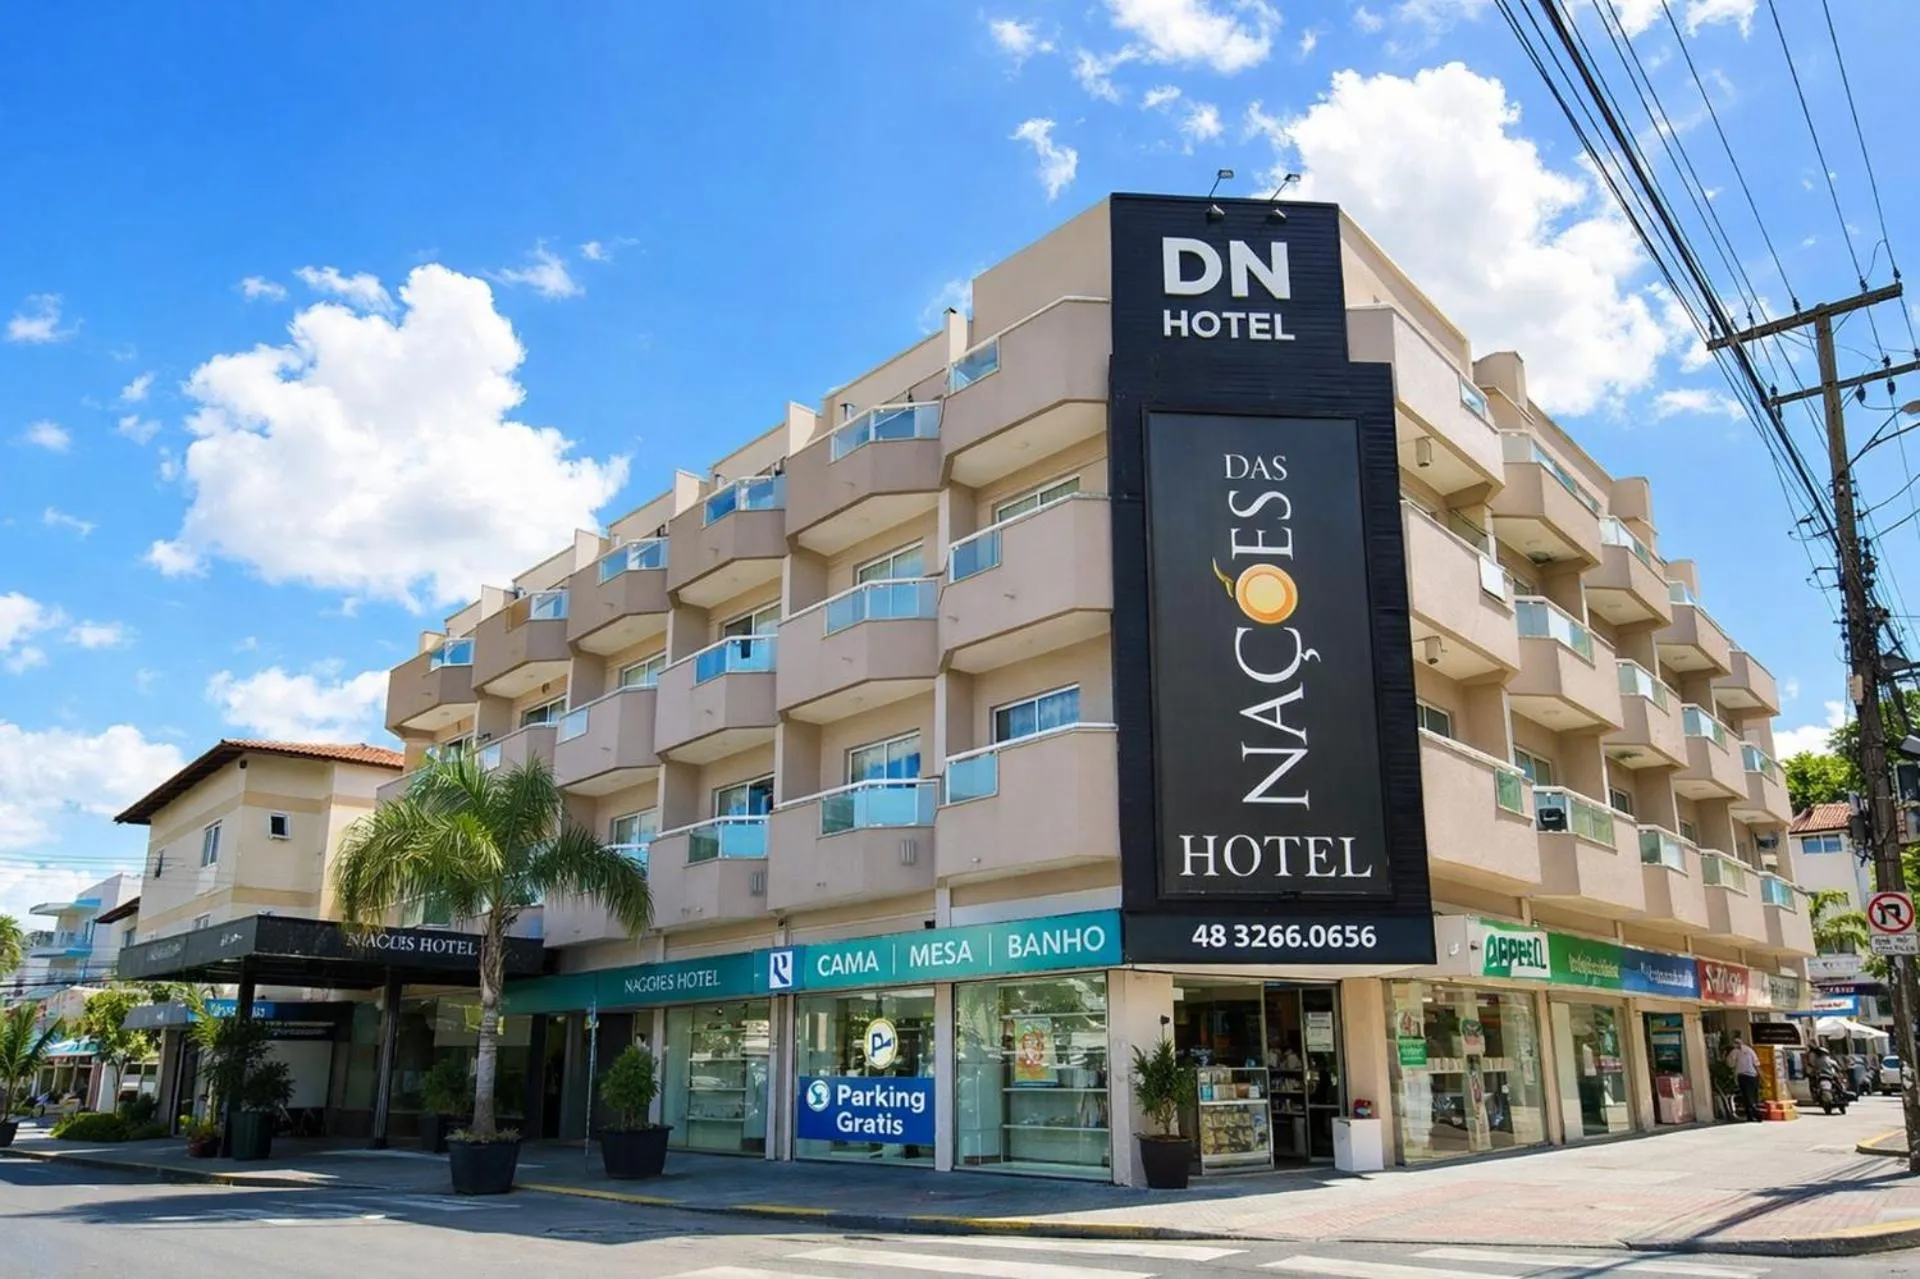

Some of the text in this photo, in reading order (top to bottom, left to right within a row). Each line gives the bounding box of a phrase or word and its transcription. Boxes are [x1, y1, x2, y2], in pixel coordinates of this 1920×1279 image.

[1161, 236, 1292, 300] DN
[1162, 310, 1296, 341] HOTEL
[1223, 453, 1289, 481] DAS
[1178, 833, 1373, 879] HOTEL
[419, 936, 478, 956] HOTEL
[1191, 923, 1378, 949] 48 3266.0656
[817, 925, 1106, 977] CAMA MESA BANHO
[676, 969, 721, 989] HOTEL
[836, 1084, 926, 1113] Parking
[836, 1111, 904, 1136] Gratis
